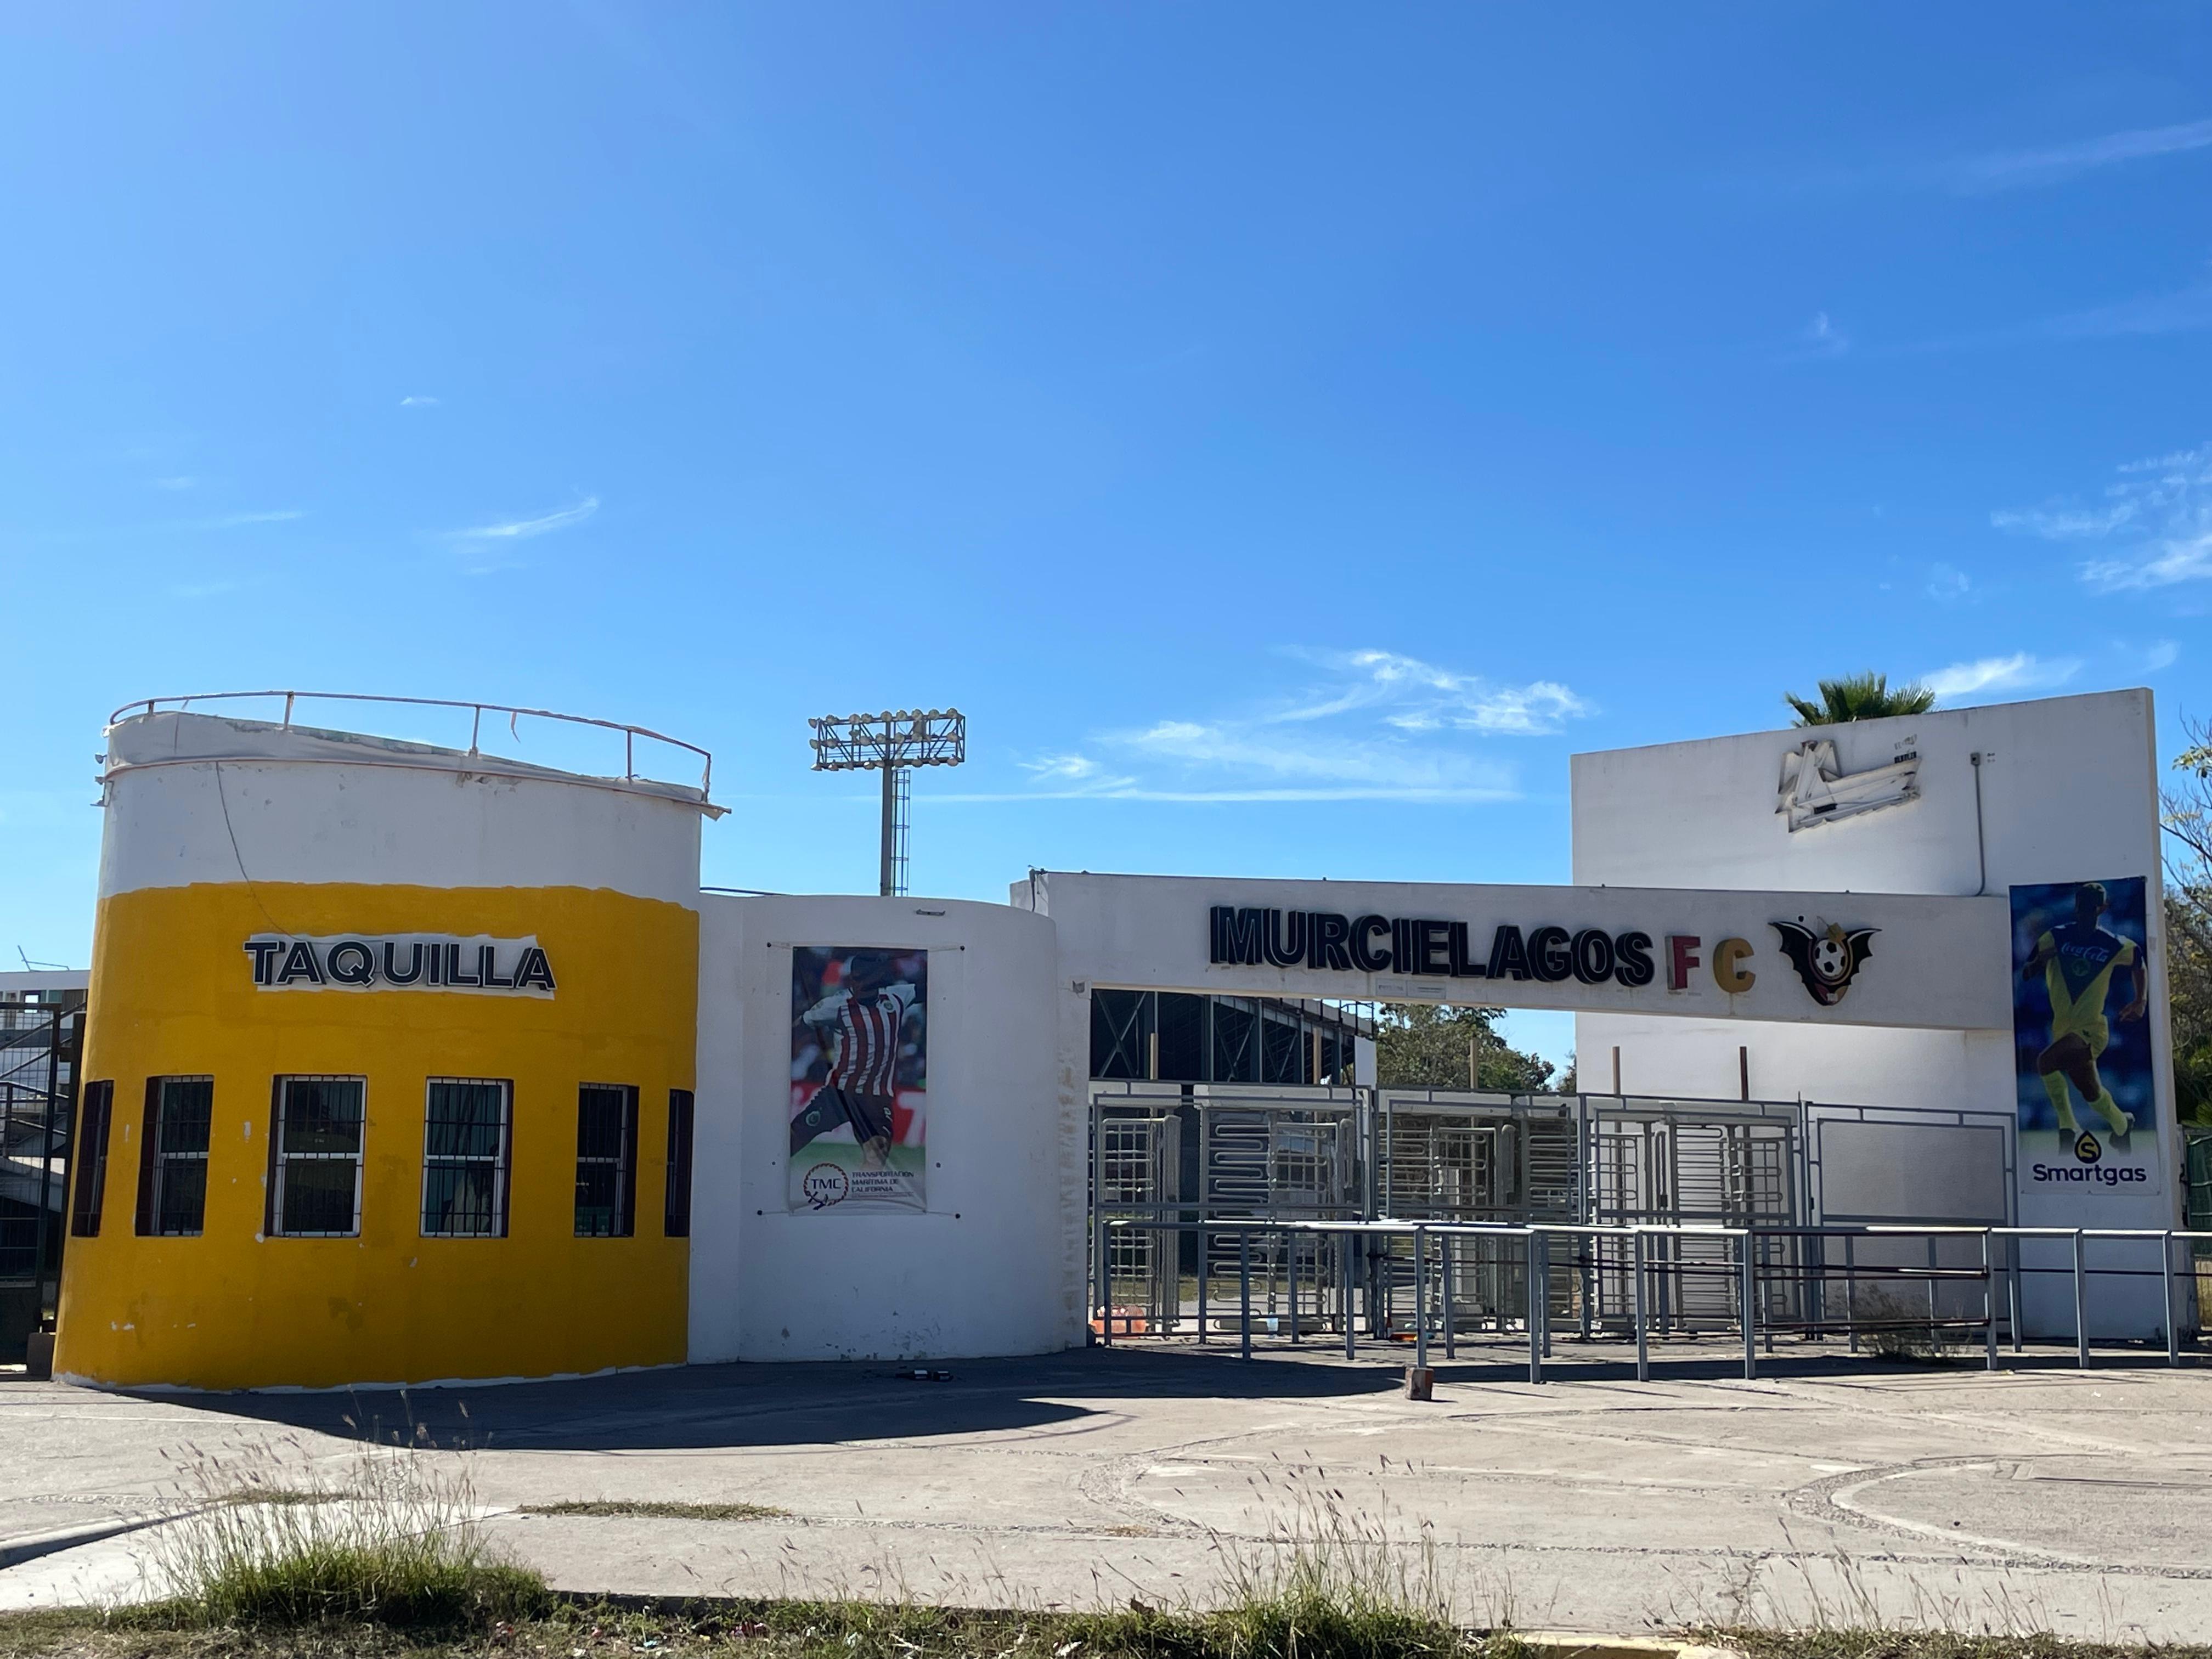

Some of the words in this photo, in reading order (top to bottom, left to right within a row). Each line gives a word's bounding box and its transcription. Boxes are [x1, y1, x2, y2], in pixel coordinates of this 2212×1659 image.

[1210, 905, 1655, 987] MURCIELAGOS
[243, 940, 557, 990] TAQUILLA
[810, 1178, 842, 1189] TMC
[2033, 1164, 2147, 1186] Smartgas
